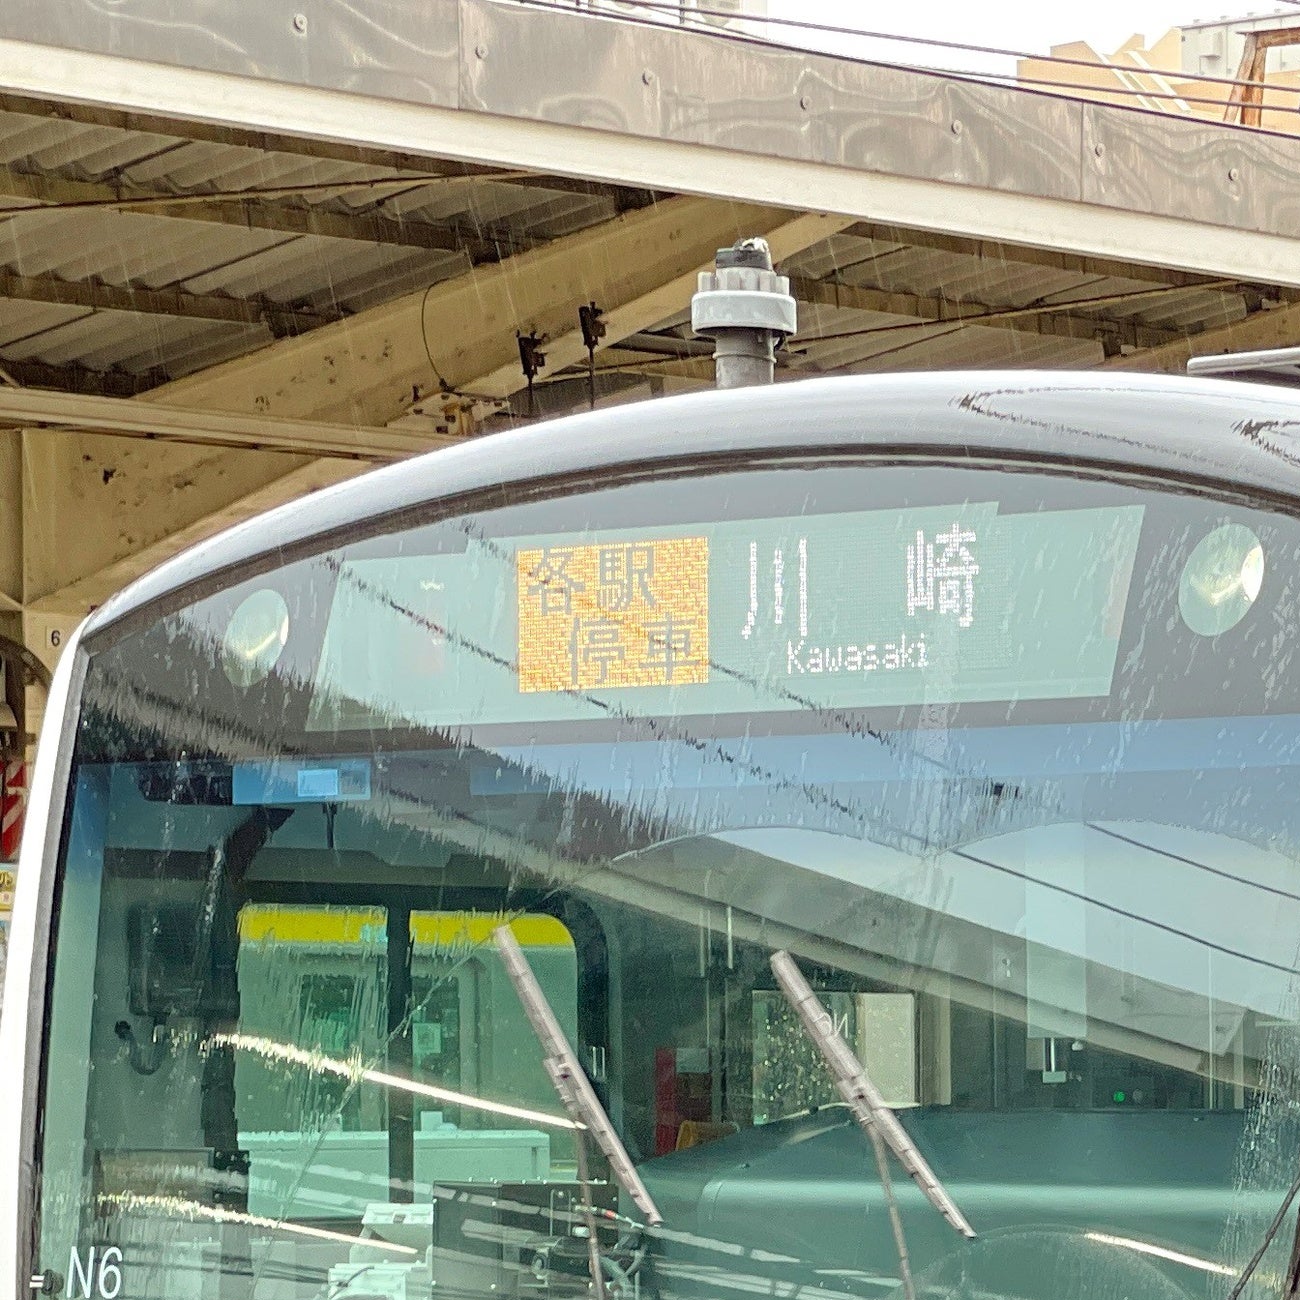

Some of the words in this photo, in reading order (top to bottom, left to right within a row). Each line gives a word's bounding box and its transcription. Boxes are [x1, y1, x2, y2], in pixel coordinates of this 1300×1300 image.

[526, 546, 656, 618] 各駅
[741, 522, 979, 640] 川崎
[568, 616, 697, 686] 停車
[786, 632, 930, 675] Kawasaki
[66, 1246, 124, 1300] N6
